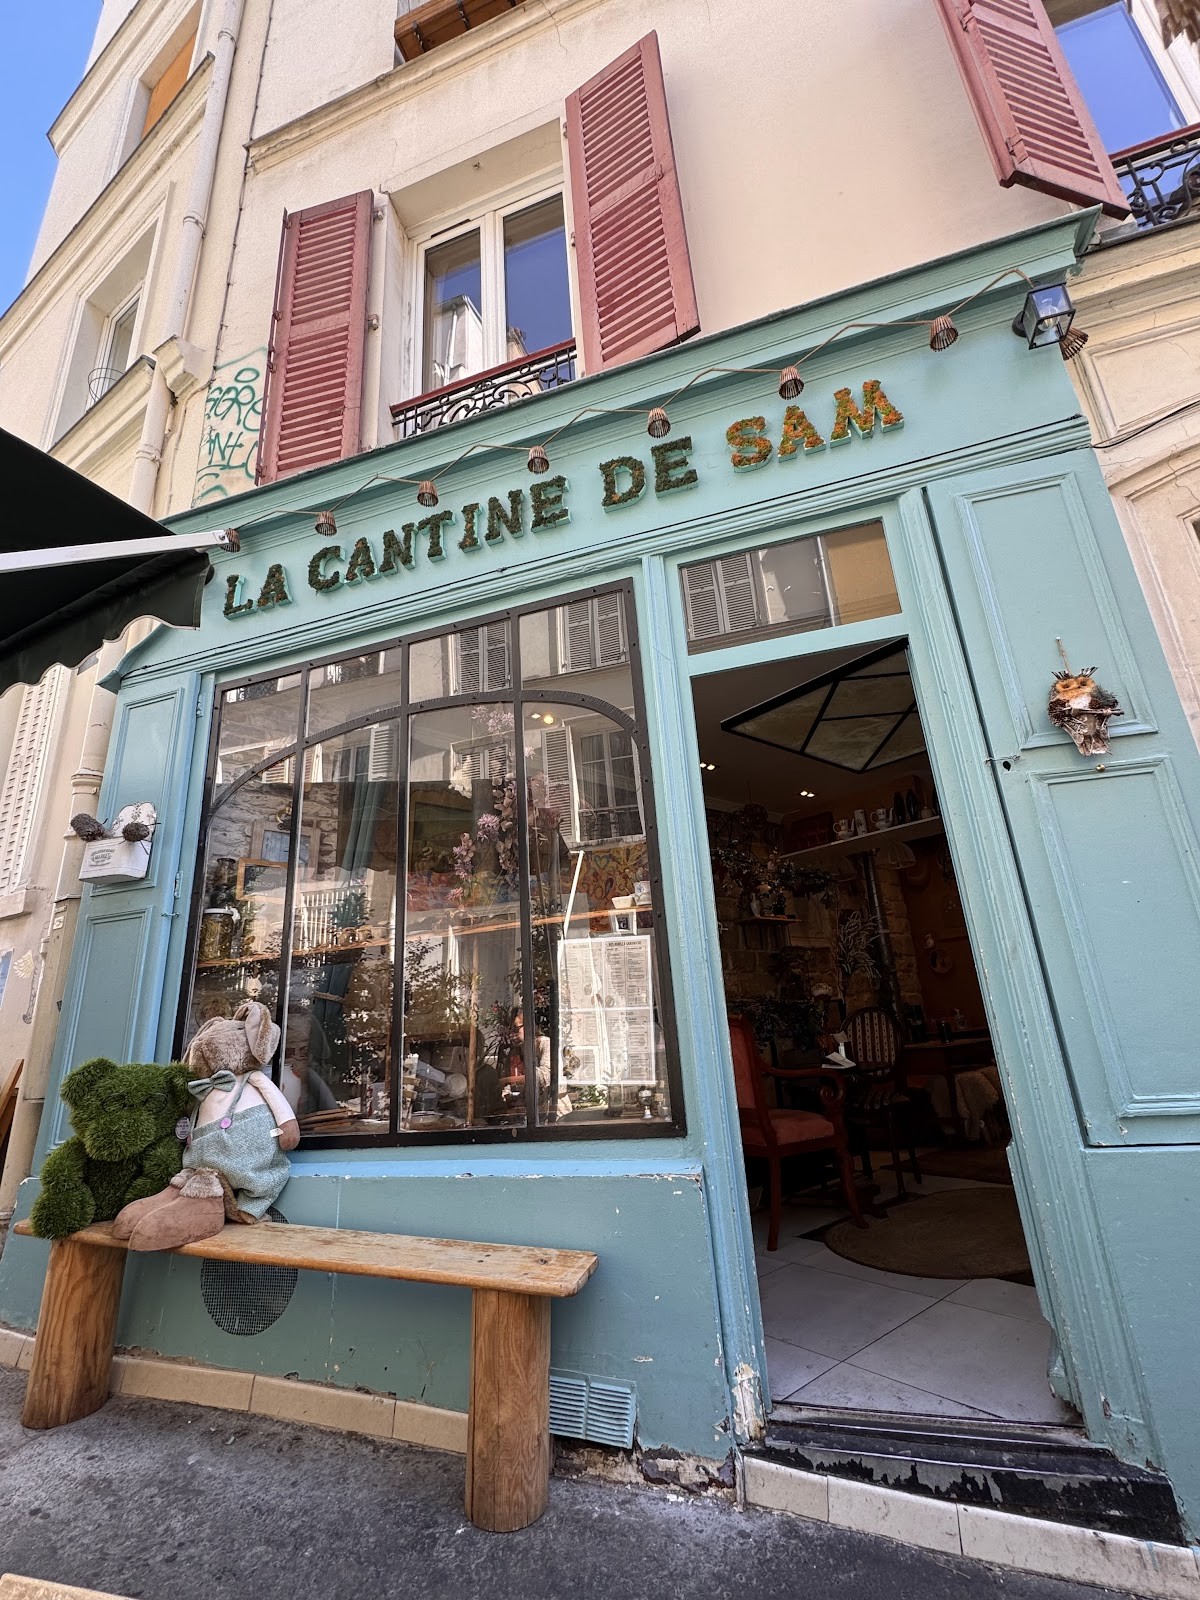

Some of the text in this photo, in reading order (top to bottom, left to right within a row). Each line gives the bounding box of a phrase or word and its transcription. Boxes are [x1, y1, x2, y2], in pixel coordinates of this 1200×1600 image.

[222, 379, 905, 620] LA CANTINE DE SAM
